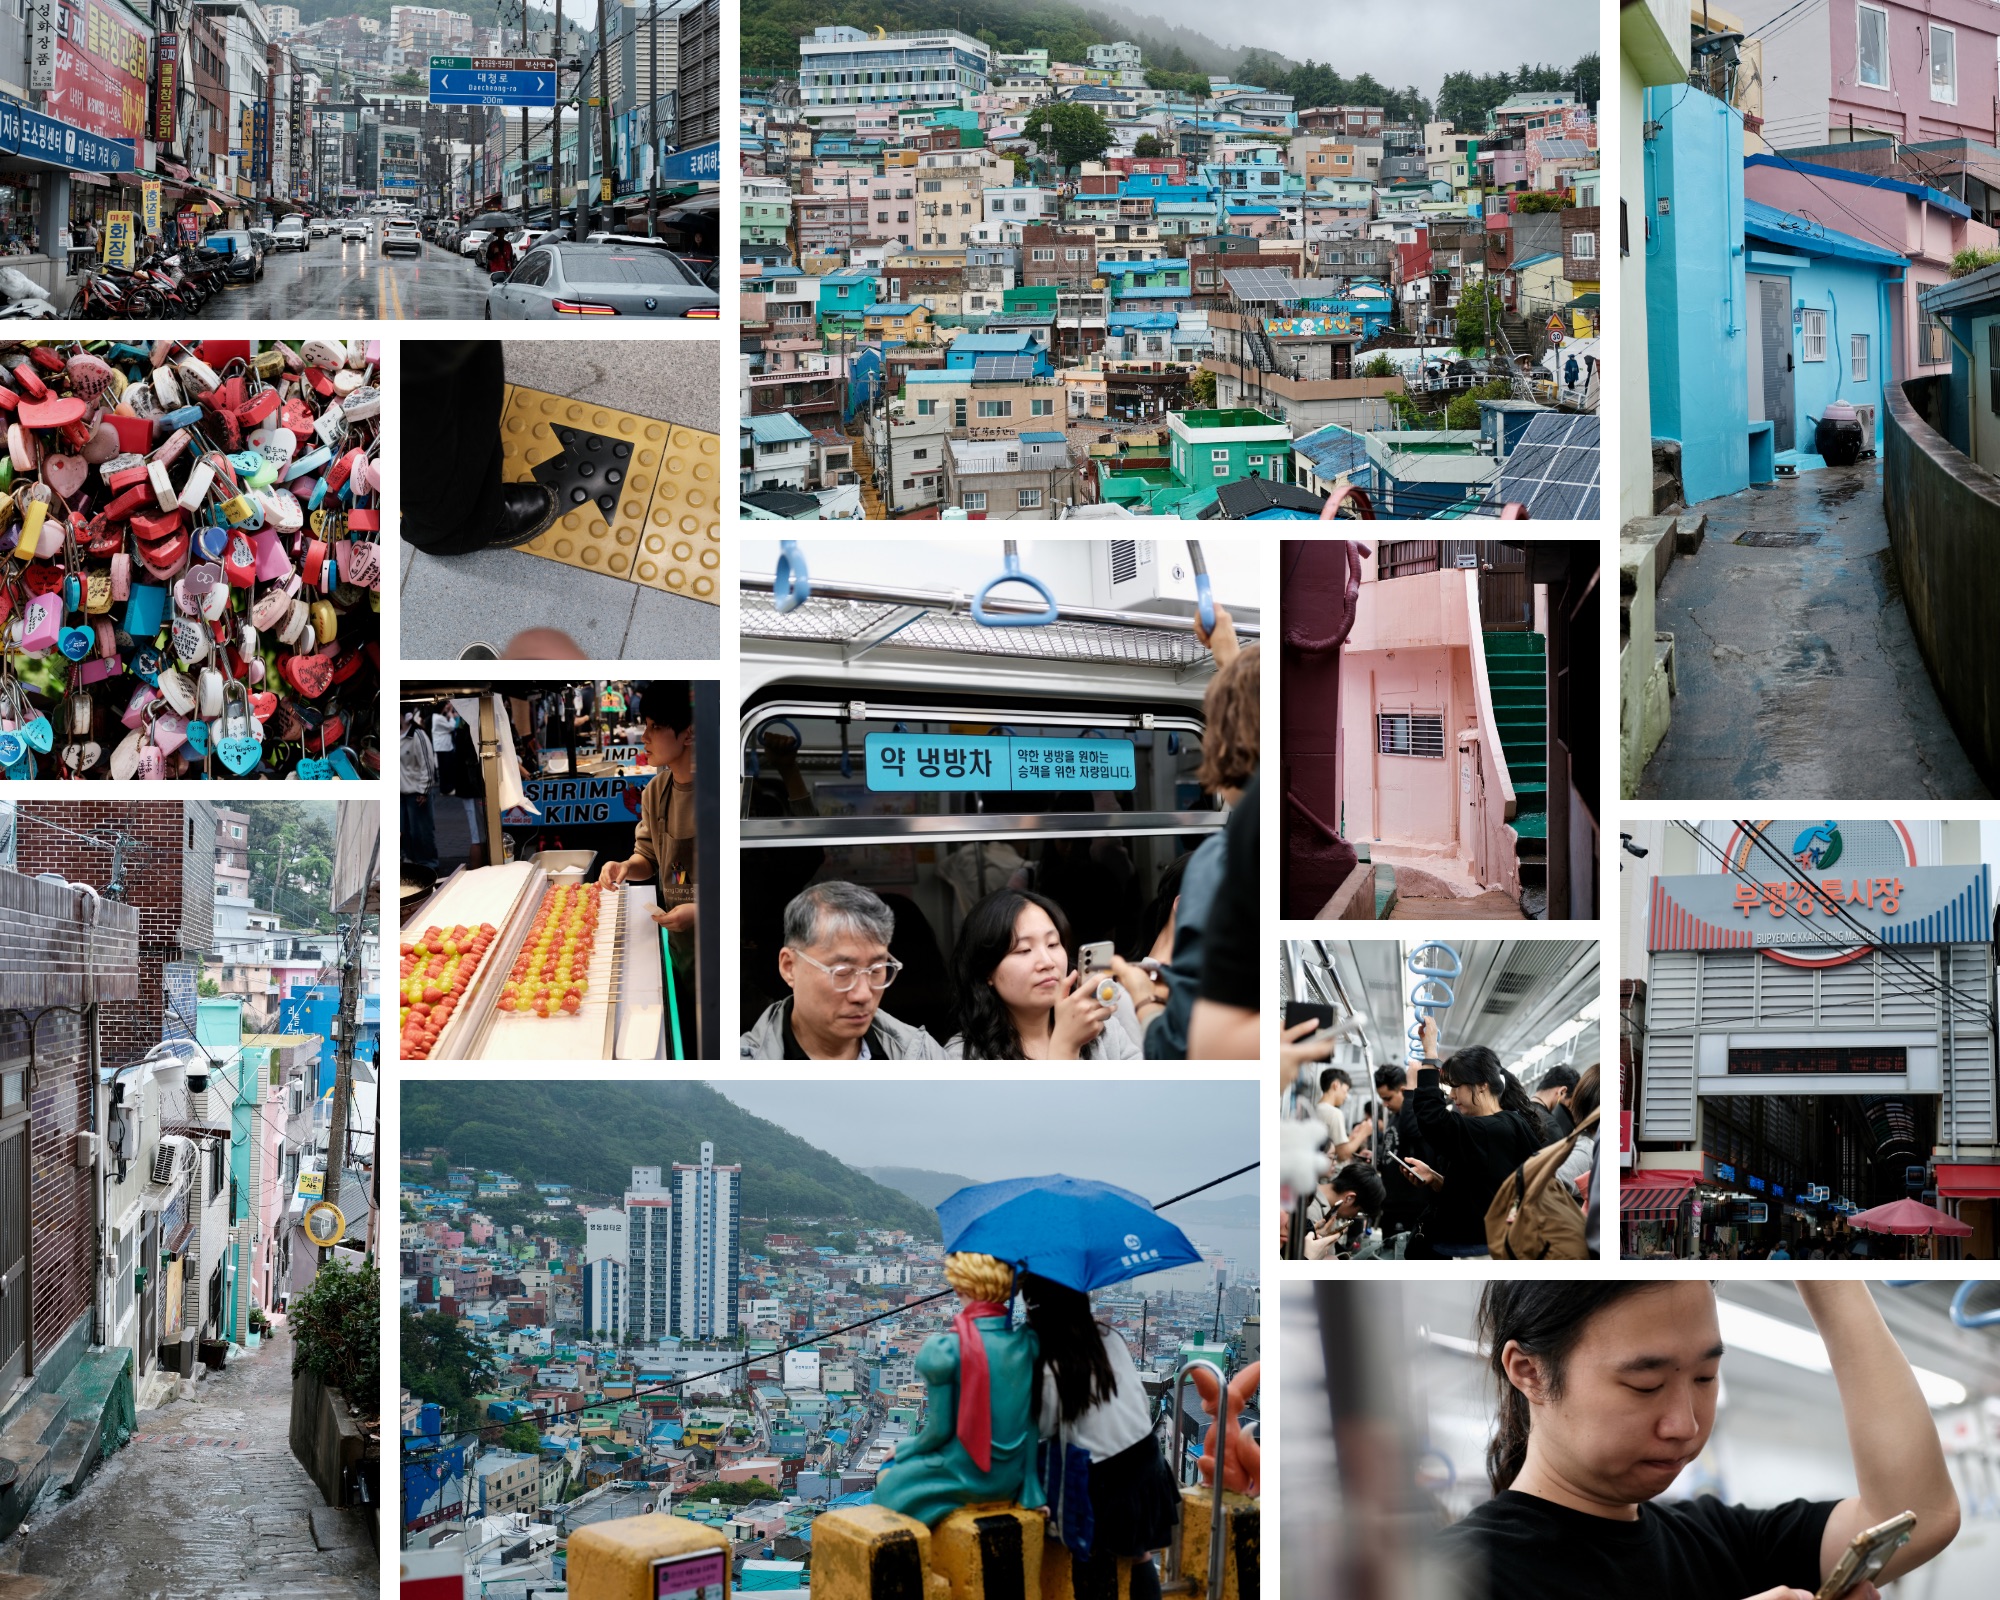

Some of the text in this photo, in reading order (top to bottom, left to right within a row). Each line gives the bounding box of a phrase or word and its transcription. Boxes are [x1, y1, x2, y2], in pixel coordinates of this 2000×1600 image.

[88, 2, 147, 85] 물류창고정리
[160, 48, 176, 61] 진짜
[440, 59, 455, 68] 하단
[524, 61, 546, 70] 부산역
[477, 73, 509, 85] 대청로
[468, 84, 517, 94] Daecheong-ro
[159, 63, 173, 139] 물류창고정리
[481, 96, 504, 105] 200m
[0, 109, 62, 154] 지하도쇼핑센터
[78, 138, 110, 168] 미술의 거리
[690, 149, 720, 176] 국제지하
[110, 214, 131, 222] 미성
[1552, 332, 1561, 341] 30
[880, 747, 993, 778] 약 냉방차
[1017, 749, 1109, 764] 약한 냉방을 원하는
[1018, 765, 1133, 779] 승객을 위한 차량입니다.
[525, 779, 628, 803] SHRIMP
[545, 802, 610, 825] KING
[1732, 877, 1905, 918] 부평깡통시장
[1756, 929, 1876, 945] BUPYEONG KKANGTONG MARKET
